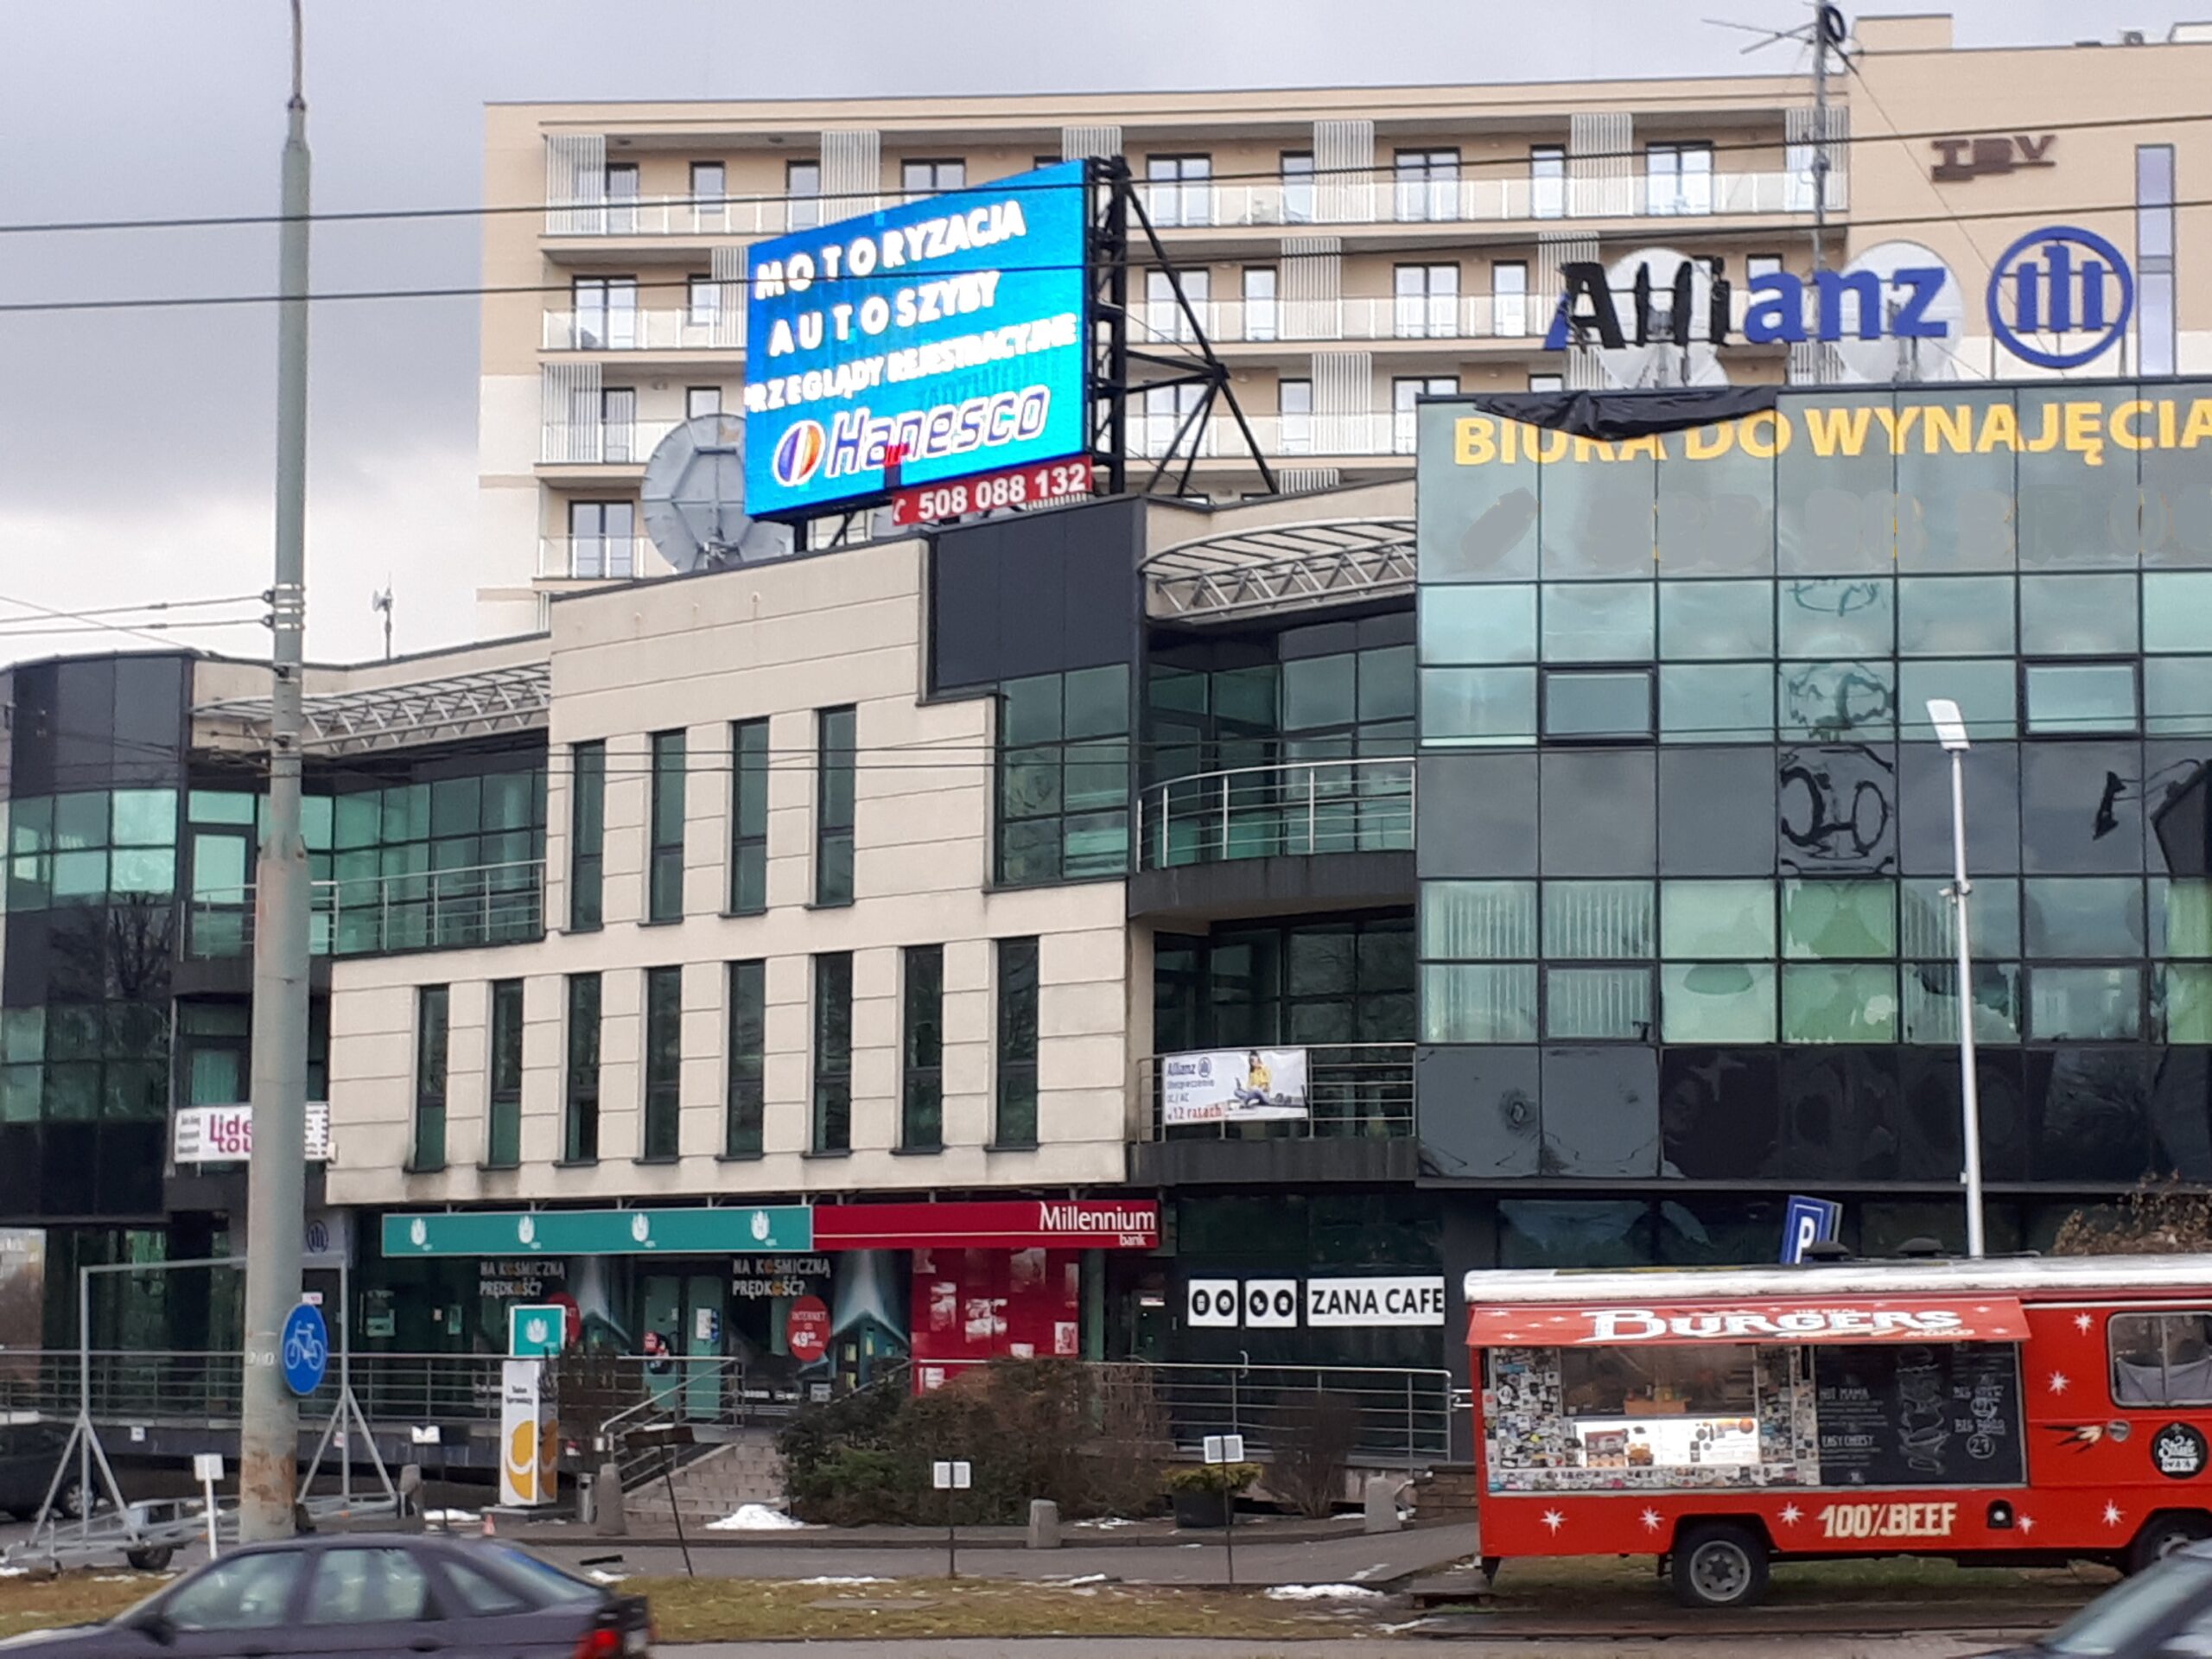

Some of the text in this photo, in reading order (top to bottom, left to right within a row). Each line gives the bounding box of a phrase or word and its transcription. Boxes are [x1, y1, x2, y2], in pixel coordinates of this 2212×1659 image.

[754, 200, 1027, 300] MOTORYZACJA
[768, 270, 1001, 356] AUTOSZYBY
[1544, 257, 1948, 352] Allianz
[825, 385, 1051, 478] Hanesco
[1684, 408, 1792, 461] DO
[1804, 398, 2212, 466] WYNAJĘCIA
[918, 463, 1087, 520] 508 088 132
[1039, 1201, 1155, 1230] Millennium
[1119, 1233, 1147, 1246] bank
[1795, 1216, 1815, 1264] P
[732, 1258, 751, 1274] NA
[1312, 1287, 1444, 1315] ZANA CAFE
